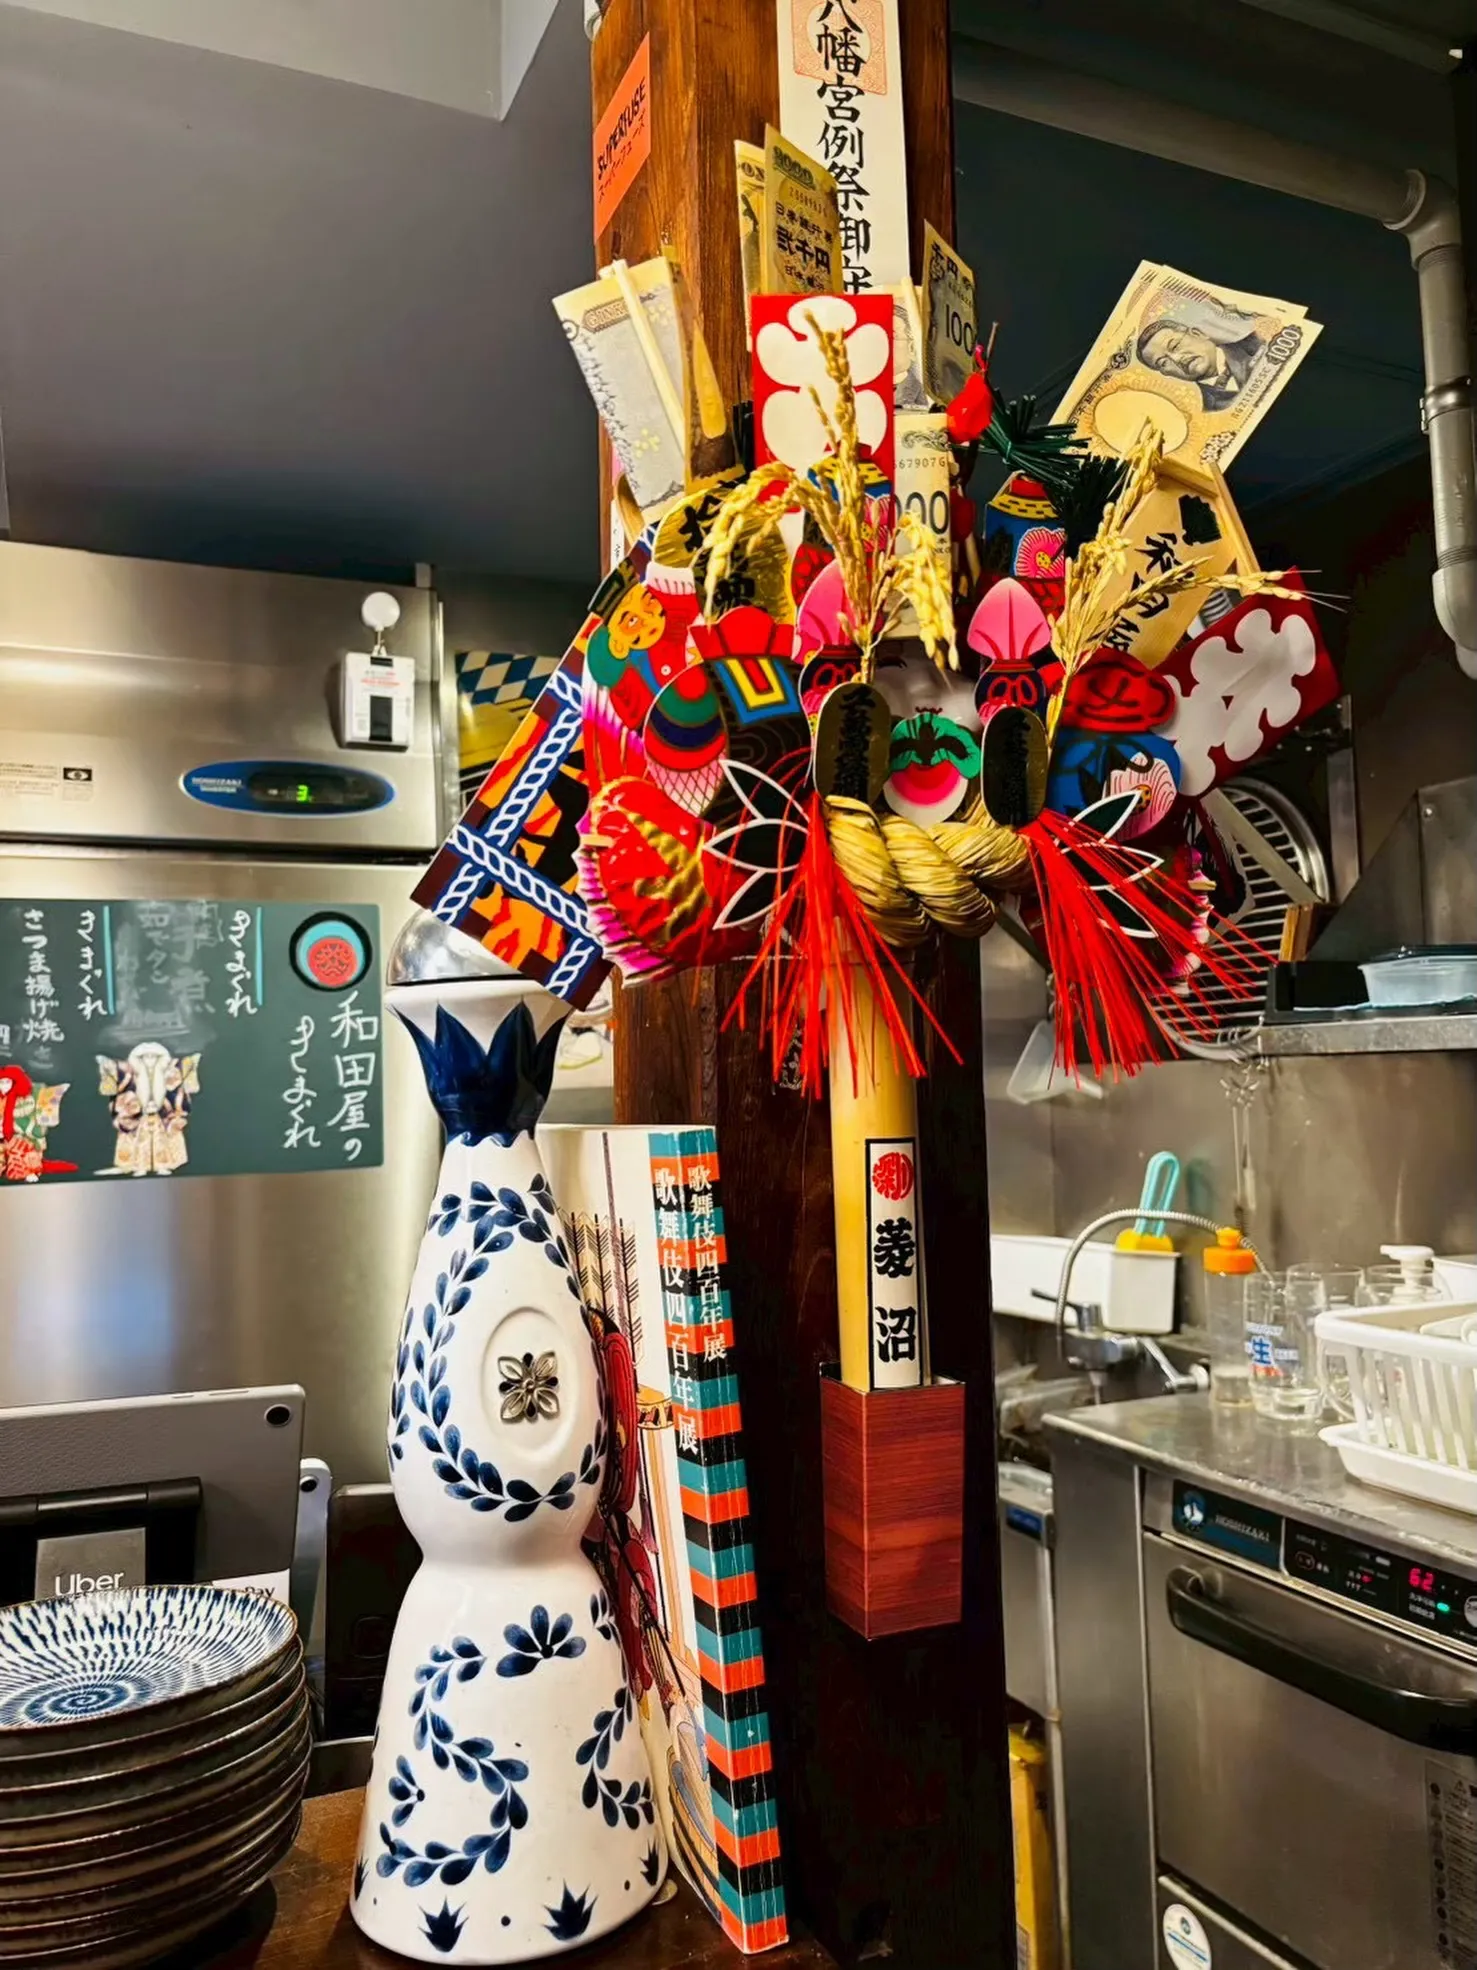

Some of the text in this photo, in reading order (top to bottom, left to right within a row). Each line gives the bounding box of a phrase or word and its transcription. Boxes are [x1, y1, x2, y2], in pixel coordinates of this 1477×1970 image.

[1267, 326, 1303, 364] 1000
[296, 784, 309, 802] 3
[77, 909, 108, 1021] きまぐれ
[224, 909, 258, 1018] きまぐれ
[282, 1015, 321, 1150] きまぐれ
[326, 990, 379, 1162] 和田屋の
[655, 1167, 699, 1456] 歌舞伎四百年展
[686, 1165, 728, 1363] 歌舞伎四百年展
[873, 1217, 917, 1363] 菱沼
[55, 1572, 124, 1596] Uber
[1409, 1567, 1434, 1592] 62
